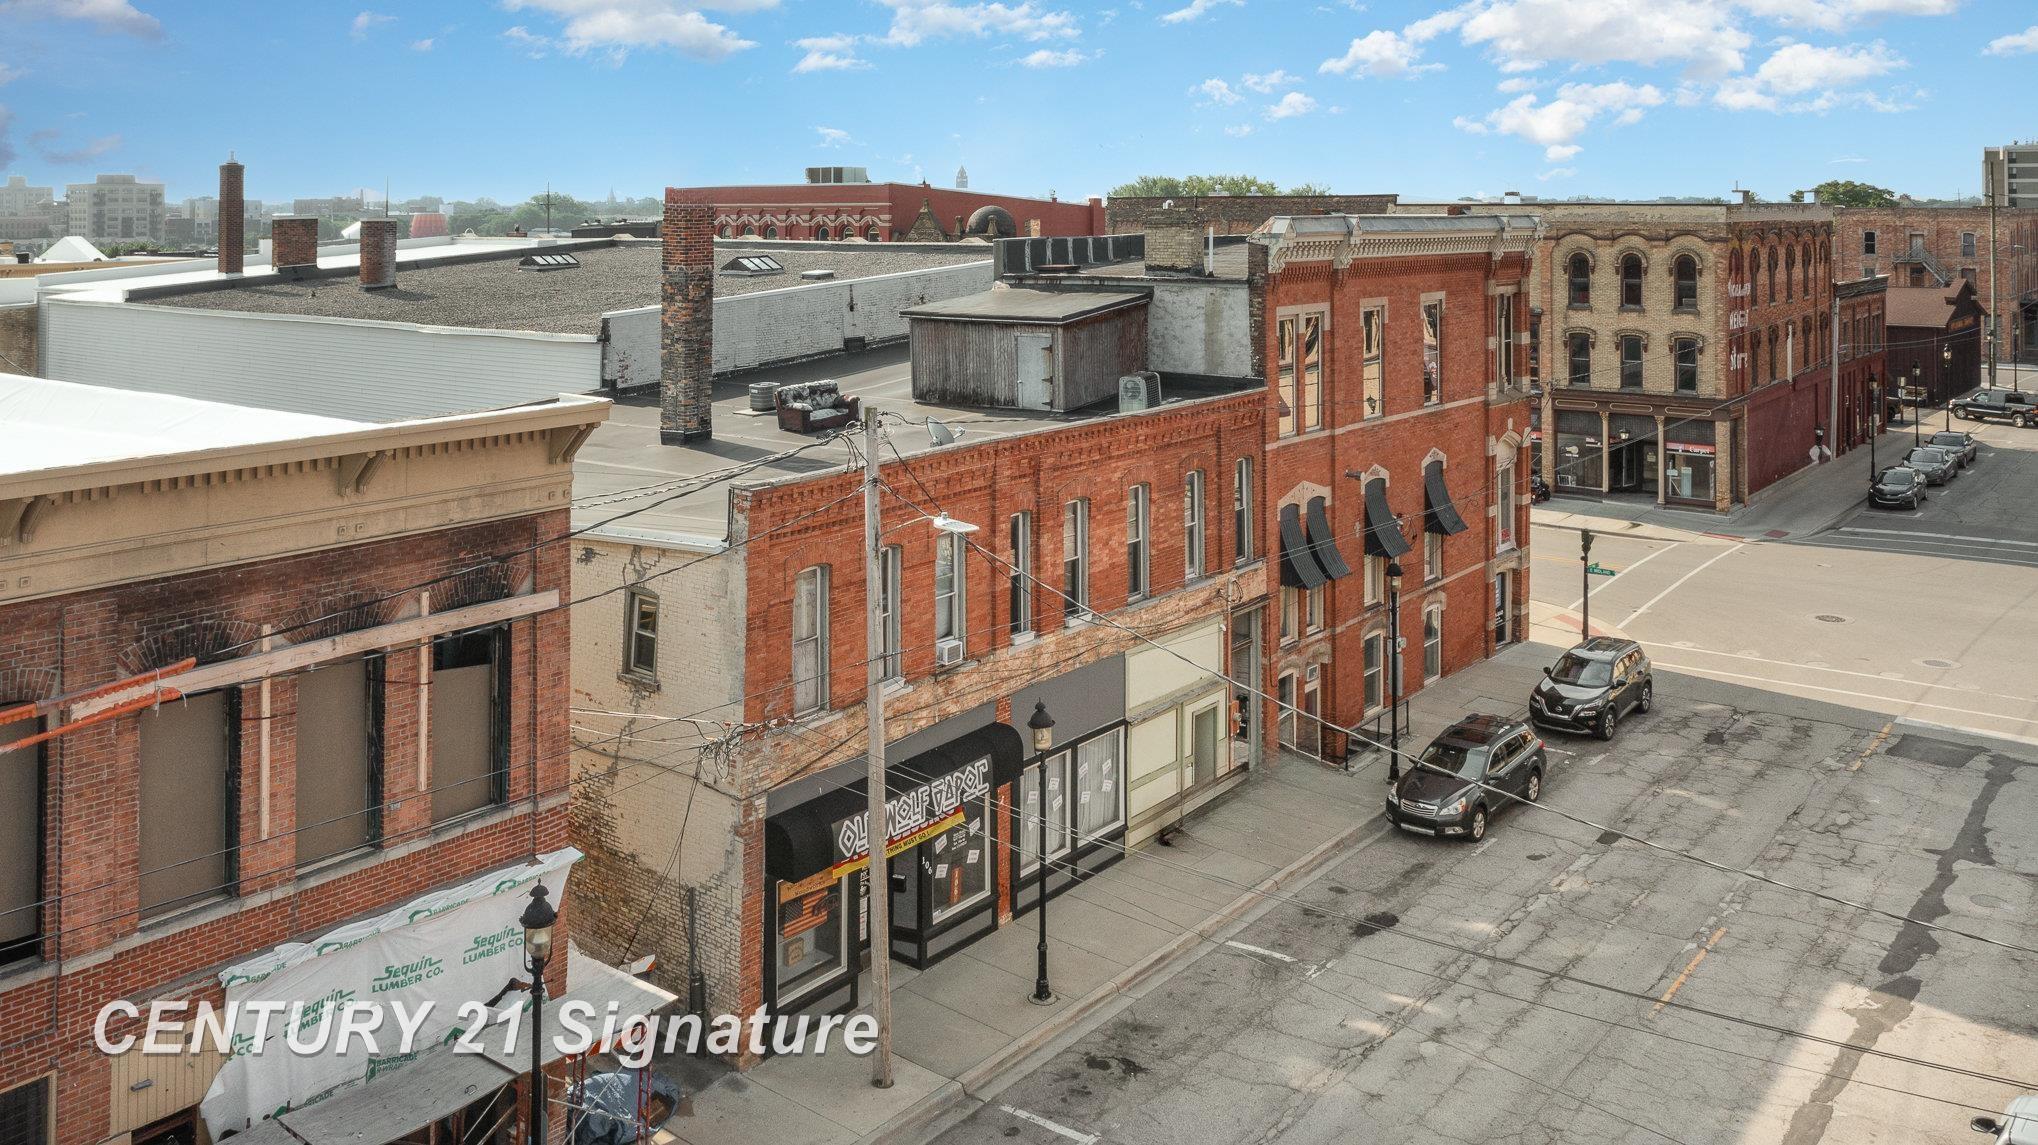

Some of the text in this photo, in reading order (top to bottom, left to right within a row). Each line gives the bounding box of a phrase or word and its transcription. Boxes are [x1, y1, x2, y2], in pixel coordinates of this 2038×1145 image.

[838, 810, 869, 858] OL
[931, 758, 990, 815] VAPOR
[903, 836, 918, 849] MUST
[922, 856, 933, 875] 106
[463, 925, 524, 954] Sequin
[463, 943, 506, 965] LUMBER
[371, 966, 444, 993] LUMBER CO.
[373, 955, 443, 982] Sequin
